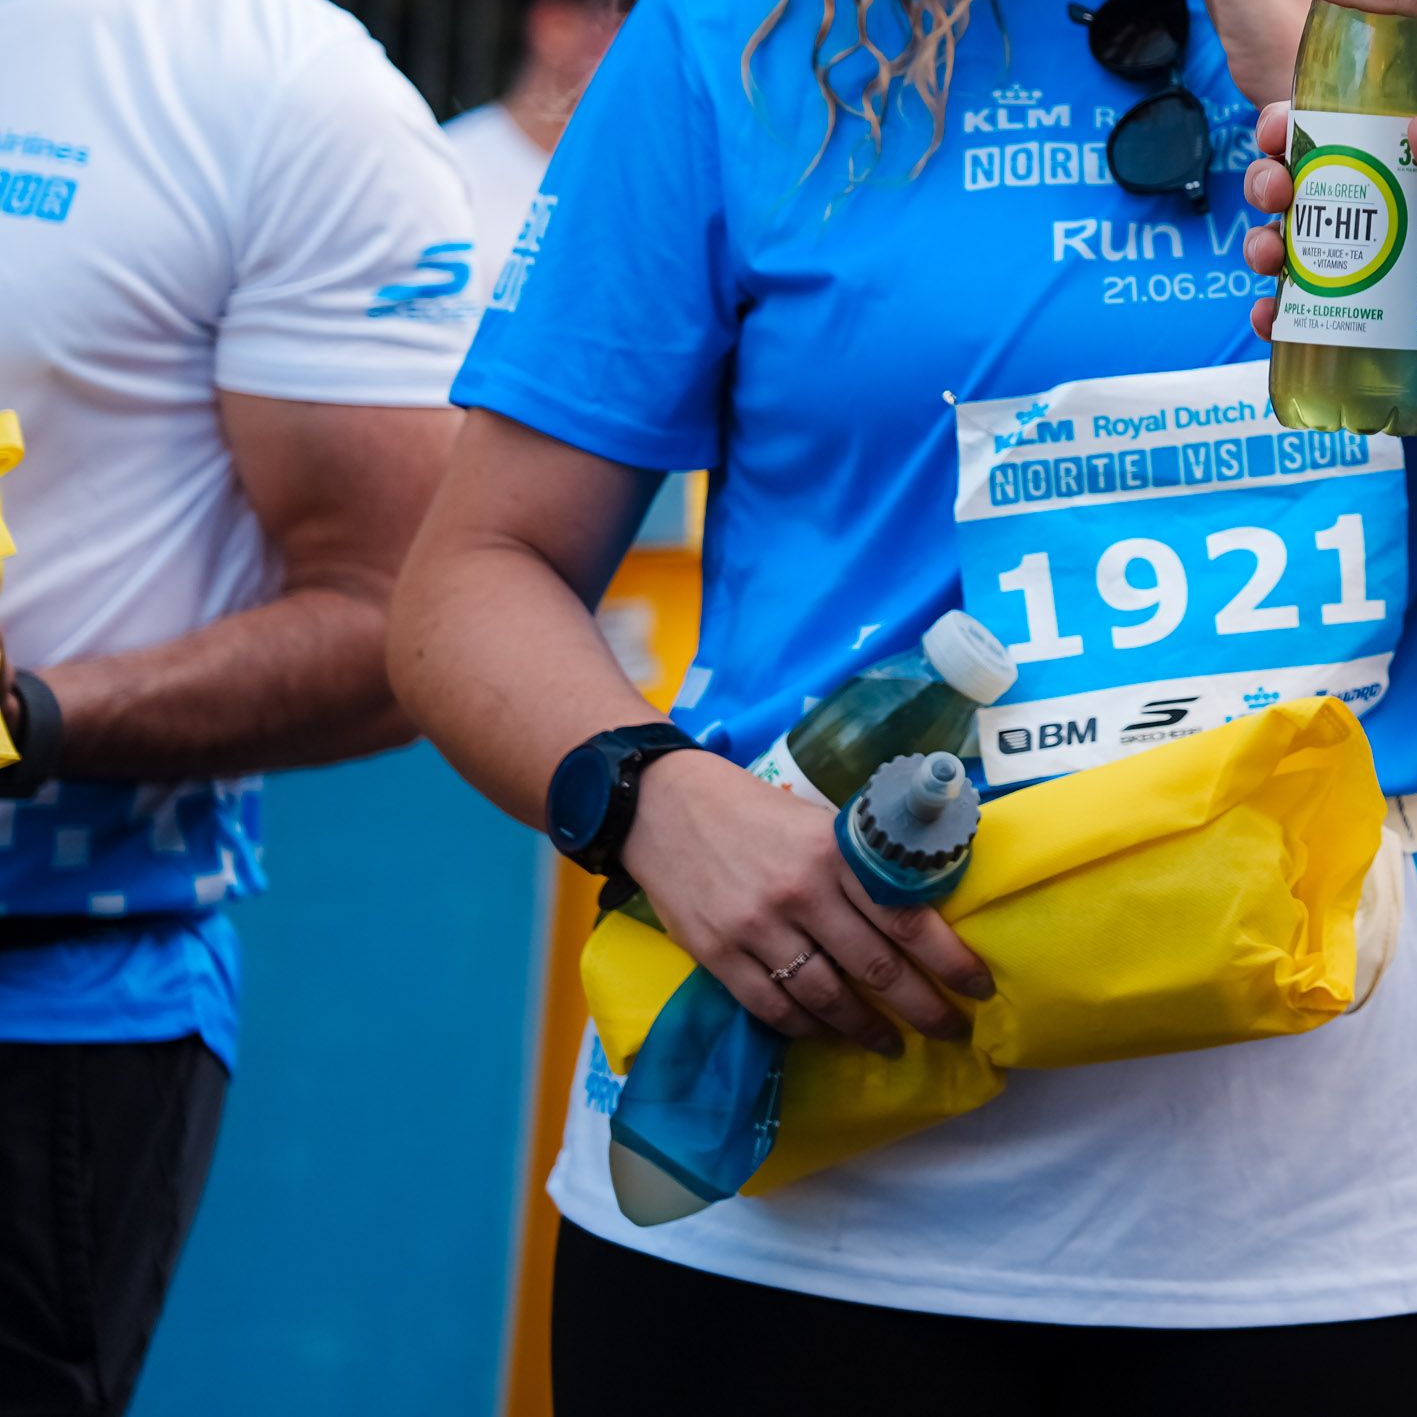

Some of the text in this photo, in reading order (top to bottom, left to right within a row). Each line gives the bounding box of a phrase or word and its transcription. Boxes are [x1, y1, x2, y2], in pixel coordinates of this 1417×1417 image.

[963, 104, 1070, 133] KLM
[965, 141, 1115, 191] NORT
[1305, 181, 1368, 199] LEAN & GREEN
[1053, 218, 1184, 262] Run
[1302, 247, 1322, 257] WATER
[1326, 248, 1344, 258] JUICE
[1350, 250, 1364, 260] TEA
[1103, 270, 1276, 304] 21.06.202
[1284, 303, 1305, 316] APPLE
[1313, 305, 1384, 321] ELDERFLOWER
[1308, 319, 1320, 329] TEA
[1325, 320, 1367, 333] L-CARNITINE
[1093, 407, 1168, 440] Royal
[1173, 400, 1259, 433] Dutch
[991, 429, 1370, 506] NORTE VS SUR
[1000, 513, 1387, 664] 1921
[1039, 717, 1097, 749] BM
